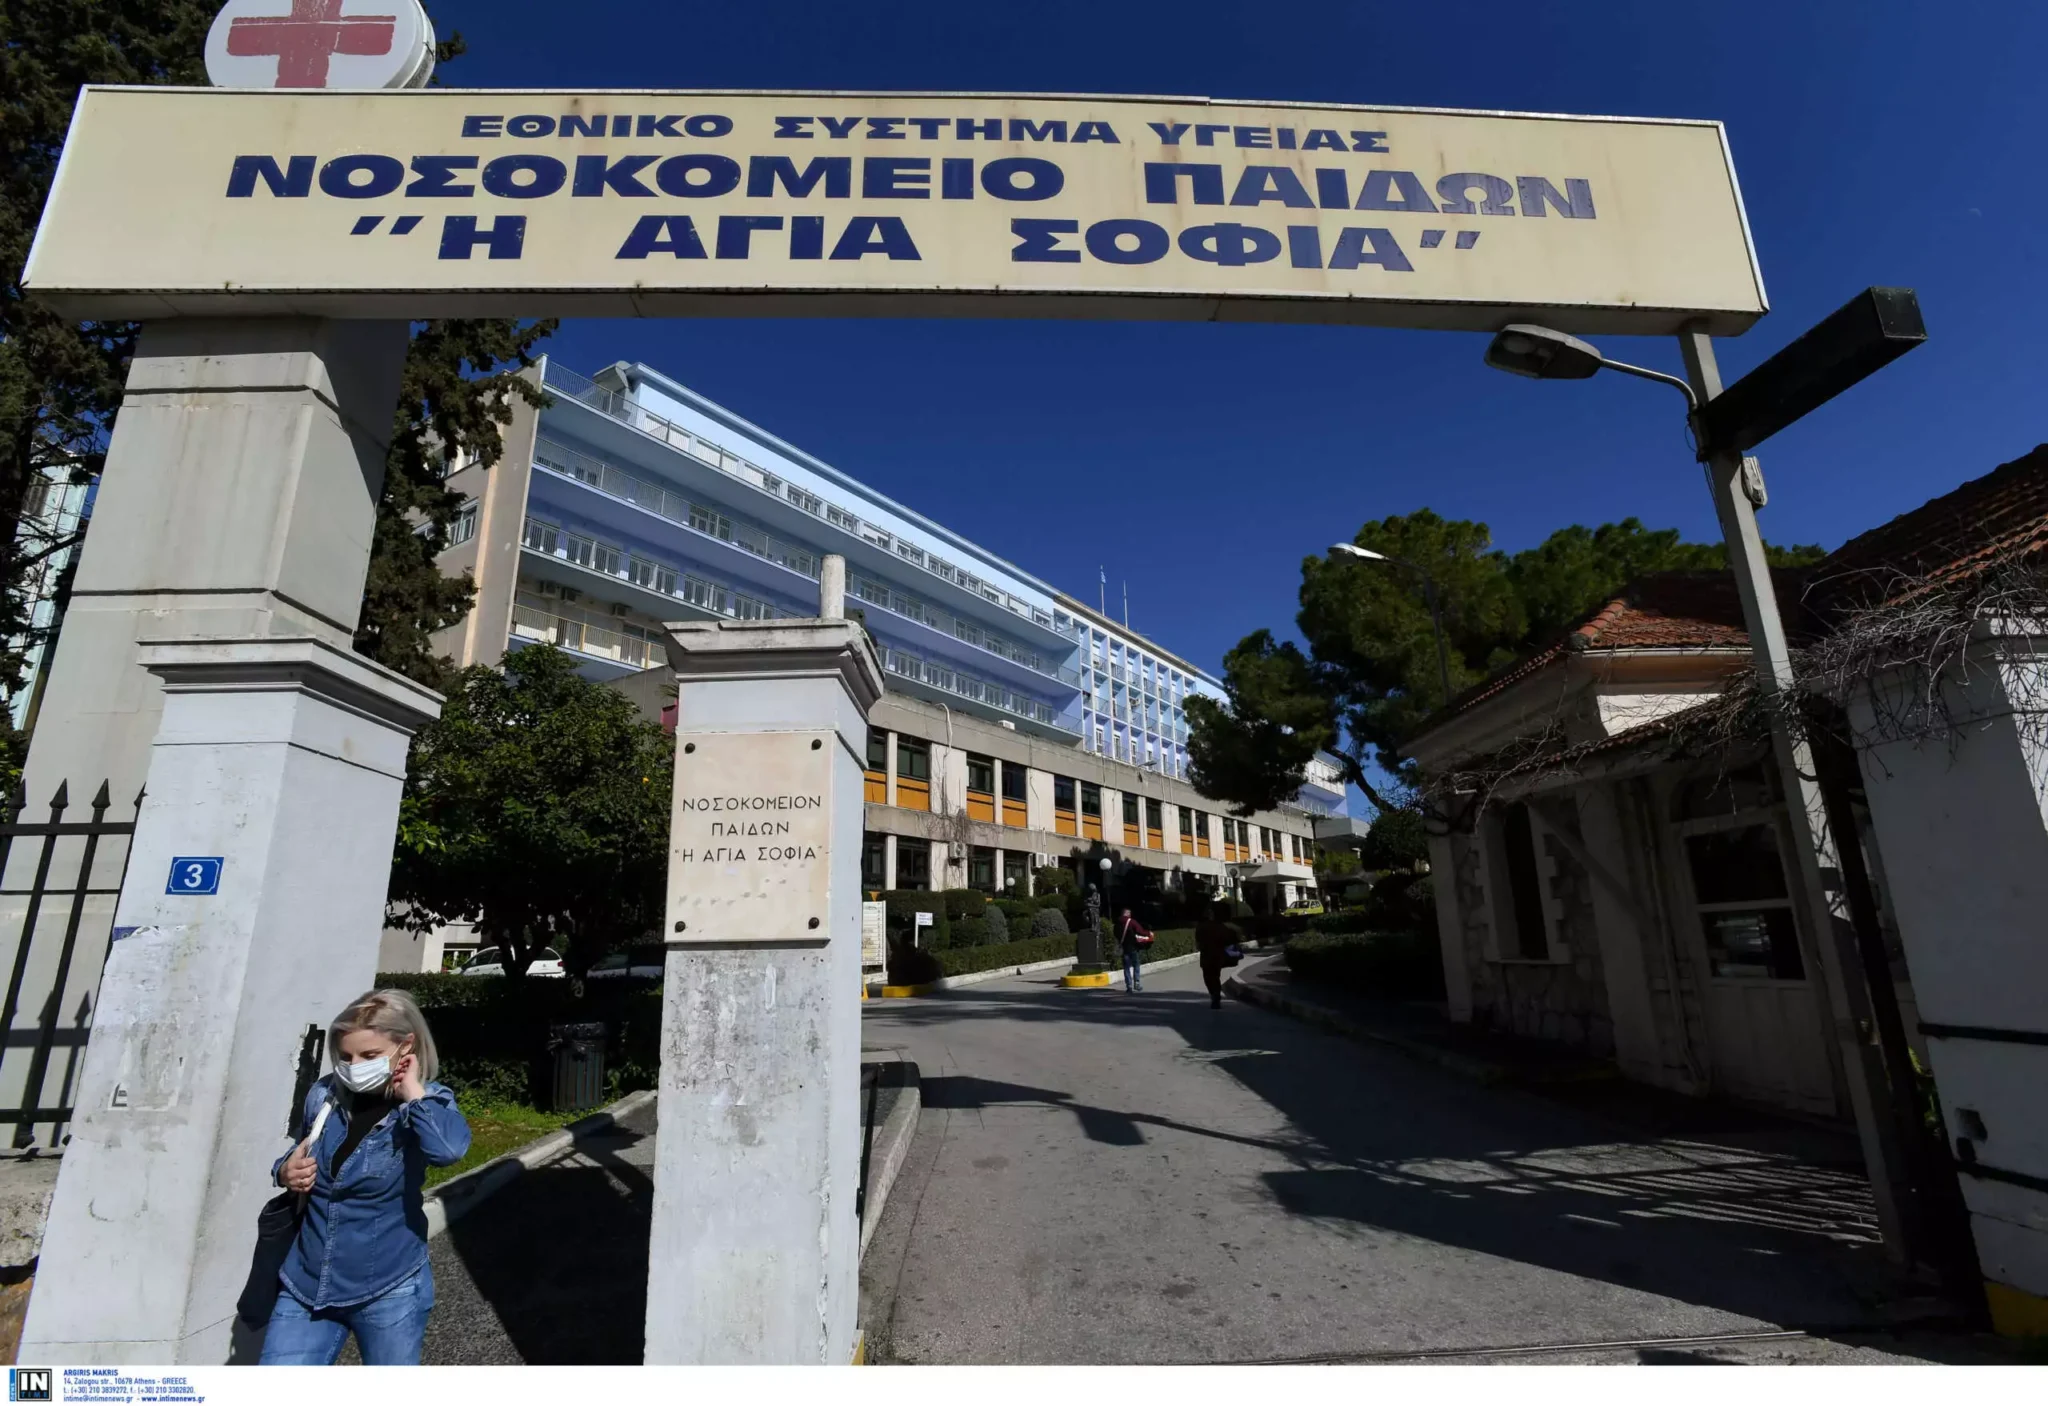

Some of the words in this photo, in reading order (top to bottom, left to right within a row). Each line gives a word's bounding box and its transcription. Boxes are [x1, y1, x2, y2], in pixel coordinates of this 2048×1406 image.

[463, 115, 733, 138] ΕΘΝΙΚΟ
[775, 117, 1119, 144] ΣΥΣΤΗΜΑ
[1150, 123, 1389, 153] ΥΓΕΙΑΣ
[227, 153, 1065, 201] ΝΟΣΟΚΟΜΕΙΟ
[1144, 162, 1596, 218] ΠΑΙΔΩΝ
[617, 215, 921, 261] ΑΓΙΑ
[682, 795, 821, 812] ΝΟΣΟΚΟΜΕΙΟΝ
[711, 821, 789, 836] ΠΑΙΔΩΝ
[702, 848, 746, 862] ΑΓΙΑ
[184, 863, 203, 888] 3
